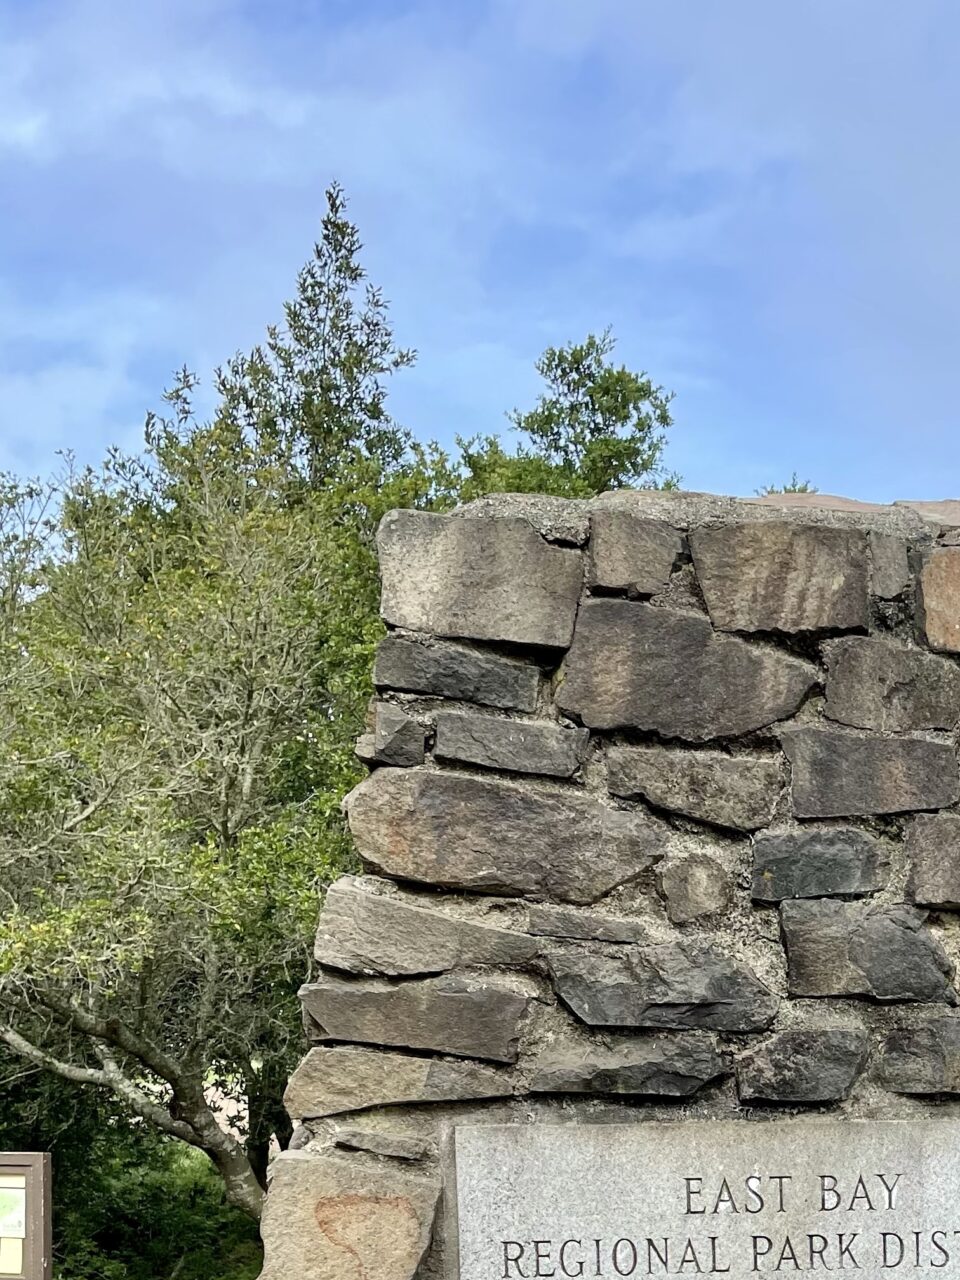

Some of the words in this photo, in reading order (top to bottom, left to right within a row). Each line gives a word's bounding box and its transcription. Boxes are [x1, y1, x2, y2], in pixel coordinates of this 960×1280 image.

[683, 1175, 793, 1215] EAST
[817, 1173, 904, 1212] BAY
[500, 1236, 731, 1279] REGIONAL
[751, 1233, 863, 1272] PARK
